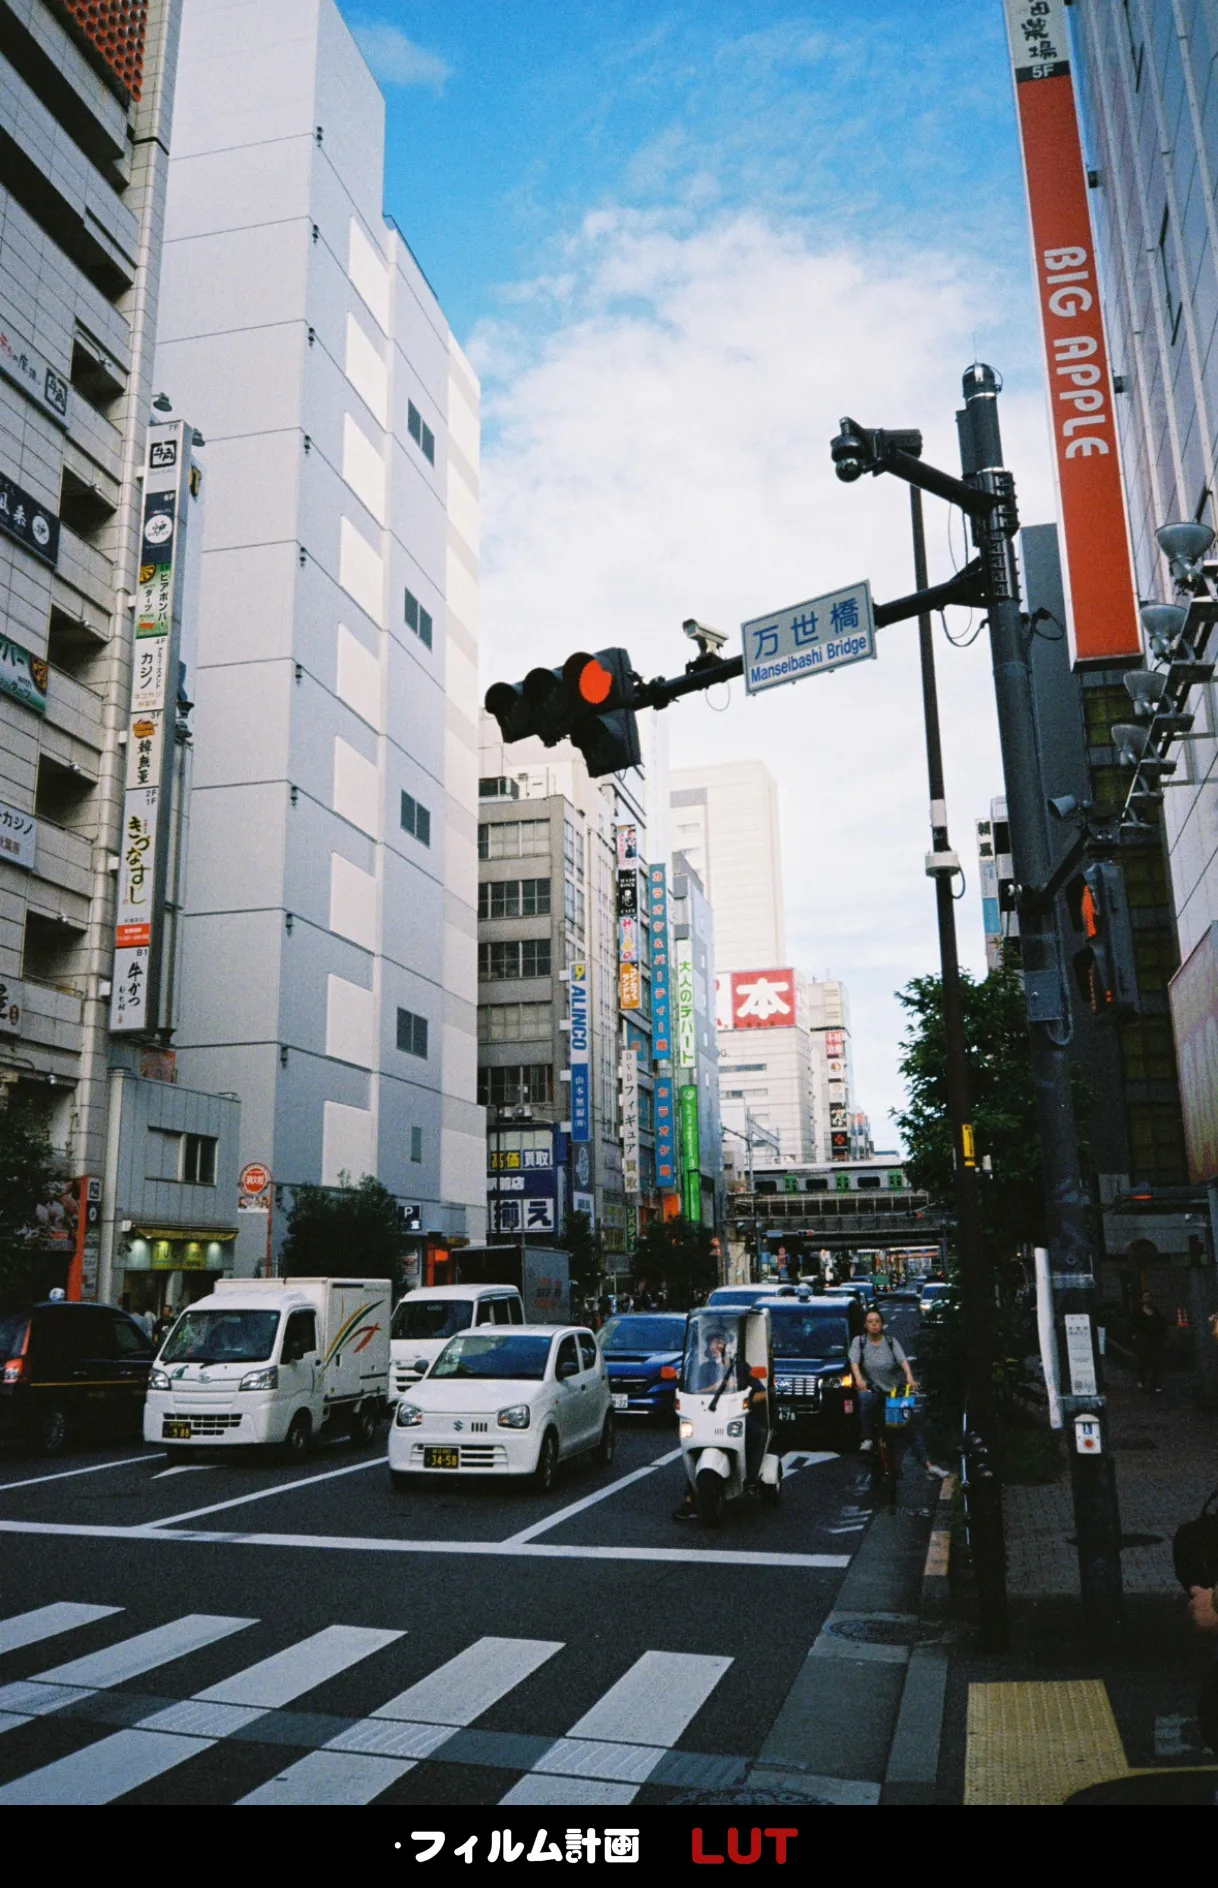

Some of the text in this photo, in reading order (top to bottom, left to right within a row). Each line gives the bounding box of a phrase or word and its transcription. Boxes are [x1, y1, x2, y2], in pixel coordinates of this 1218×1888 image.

[1032, 63, 1054, 79] 5F
[1043, 245, 1110, 459] BIG APPLE
[752, 598, 860, 661] 万世橋
[140, 652, 153, 690] カジノ
[750, 635, 867, 683] Manseibashi Bridge
[128, 961, 143, 1006] 牛かつ
[735, 977, 791, 1020] 本
[571, 984, 588, 1051] ALINCO
